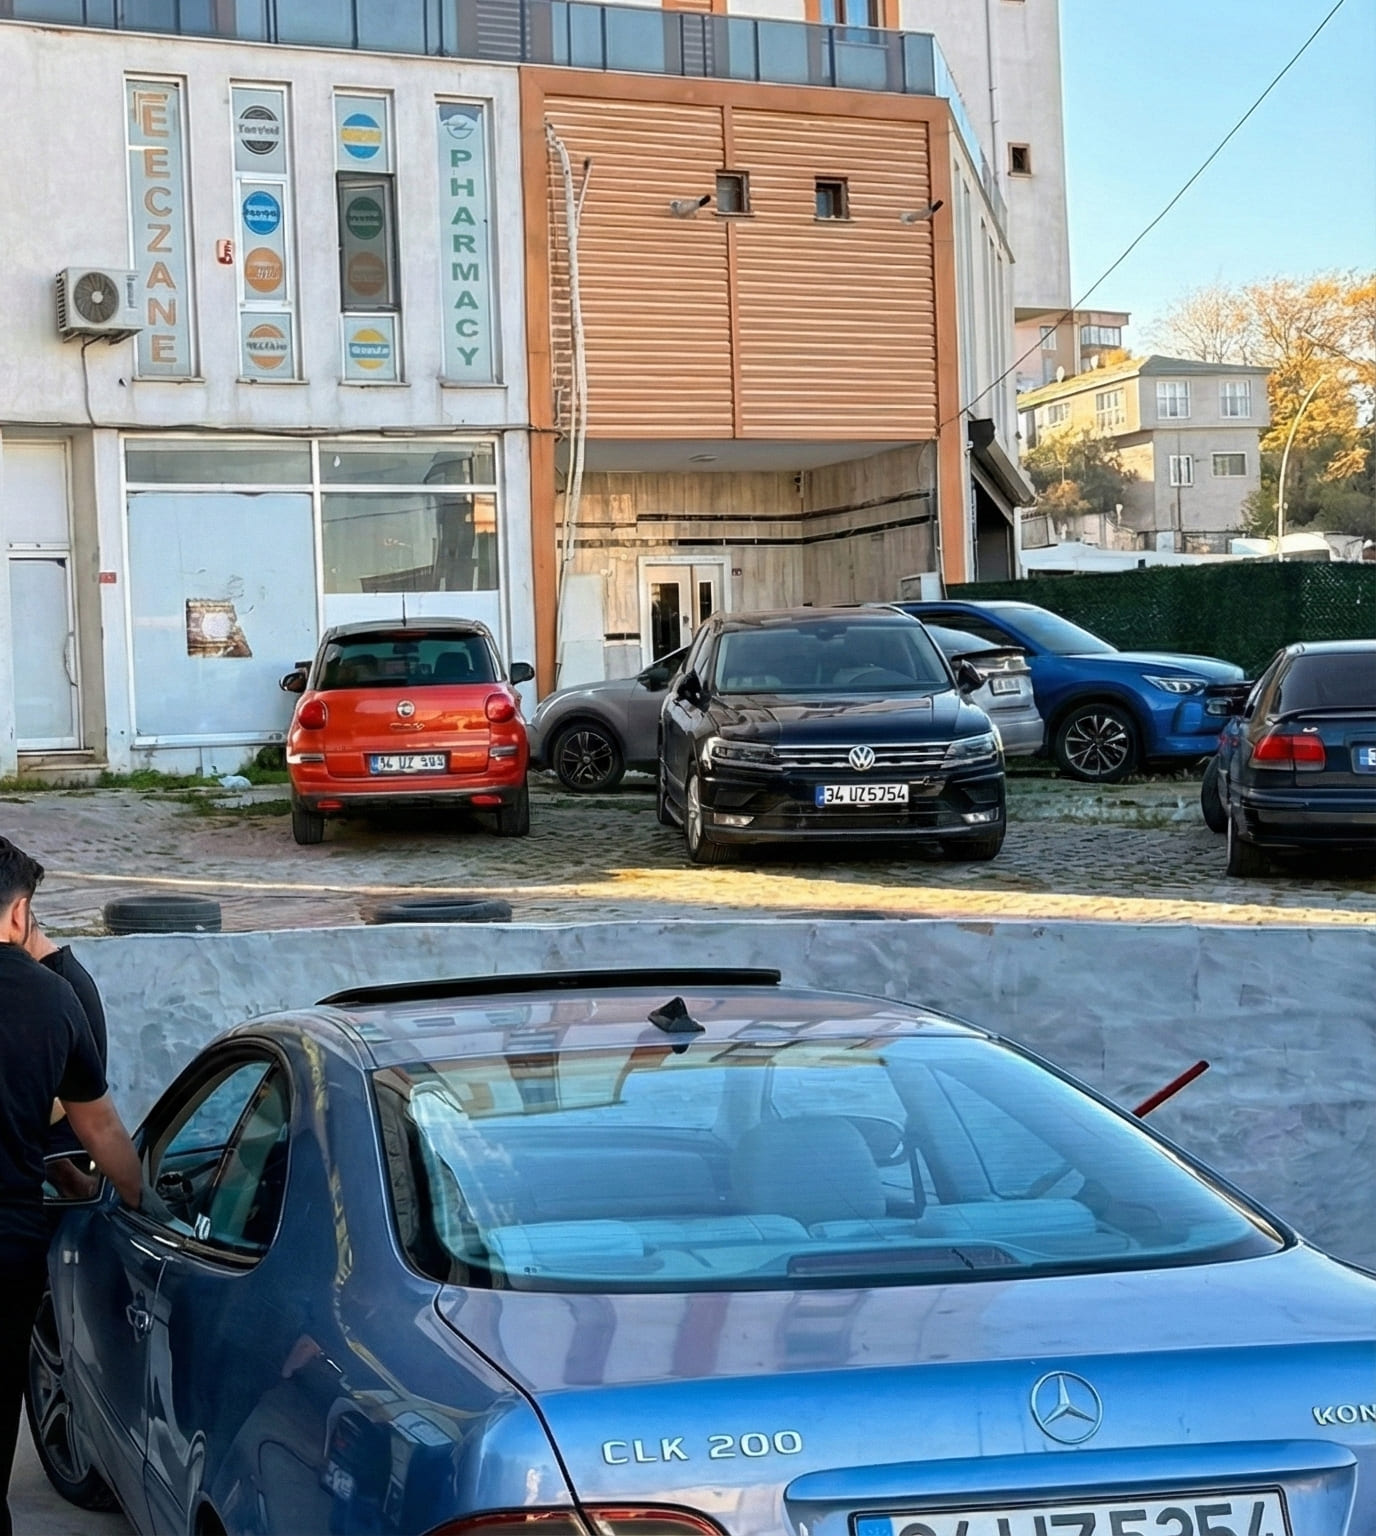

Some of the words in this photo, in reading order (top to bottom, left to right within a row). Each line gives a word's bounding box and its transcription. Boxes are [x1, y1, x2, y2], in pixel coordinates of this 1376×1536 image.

[450, 149, 480, 367] PHARMACY
[826, 786, 844, 802] 34
[602, 1437, 689, 1465] CLK
[708, 1429, 804, 1460] 200
